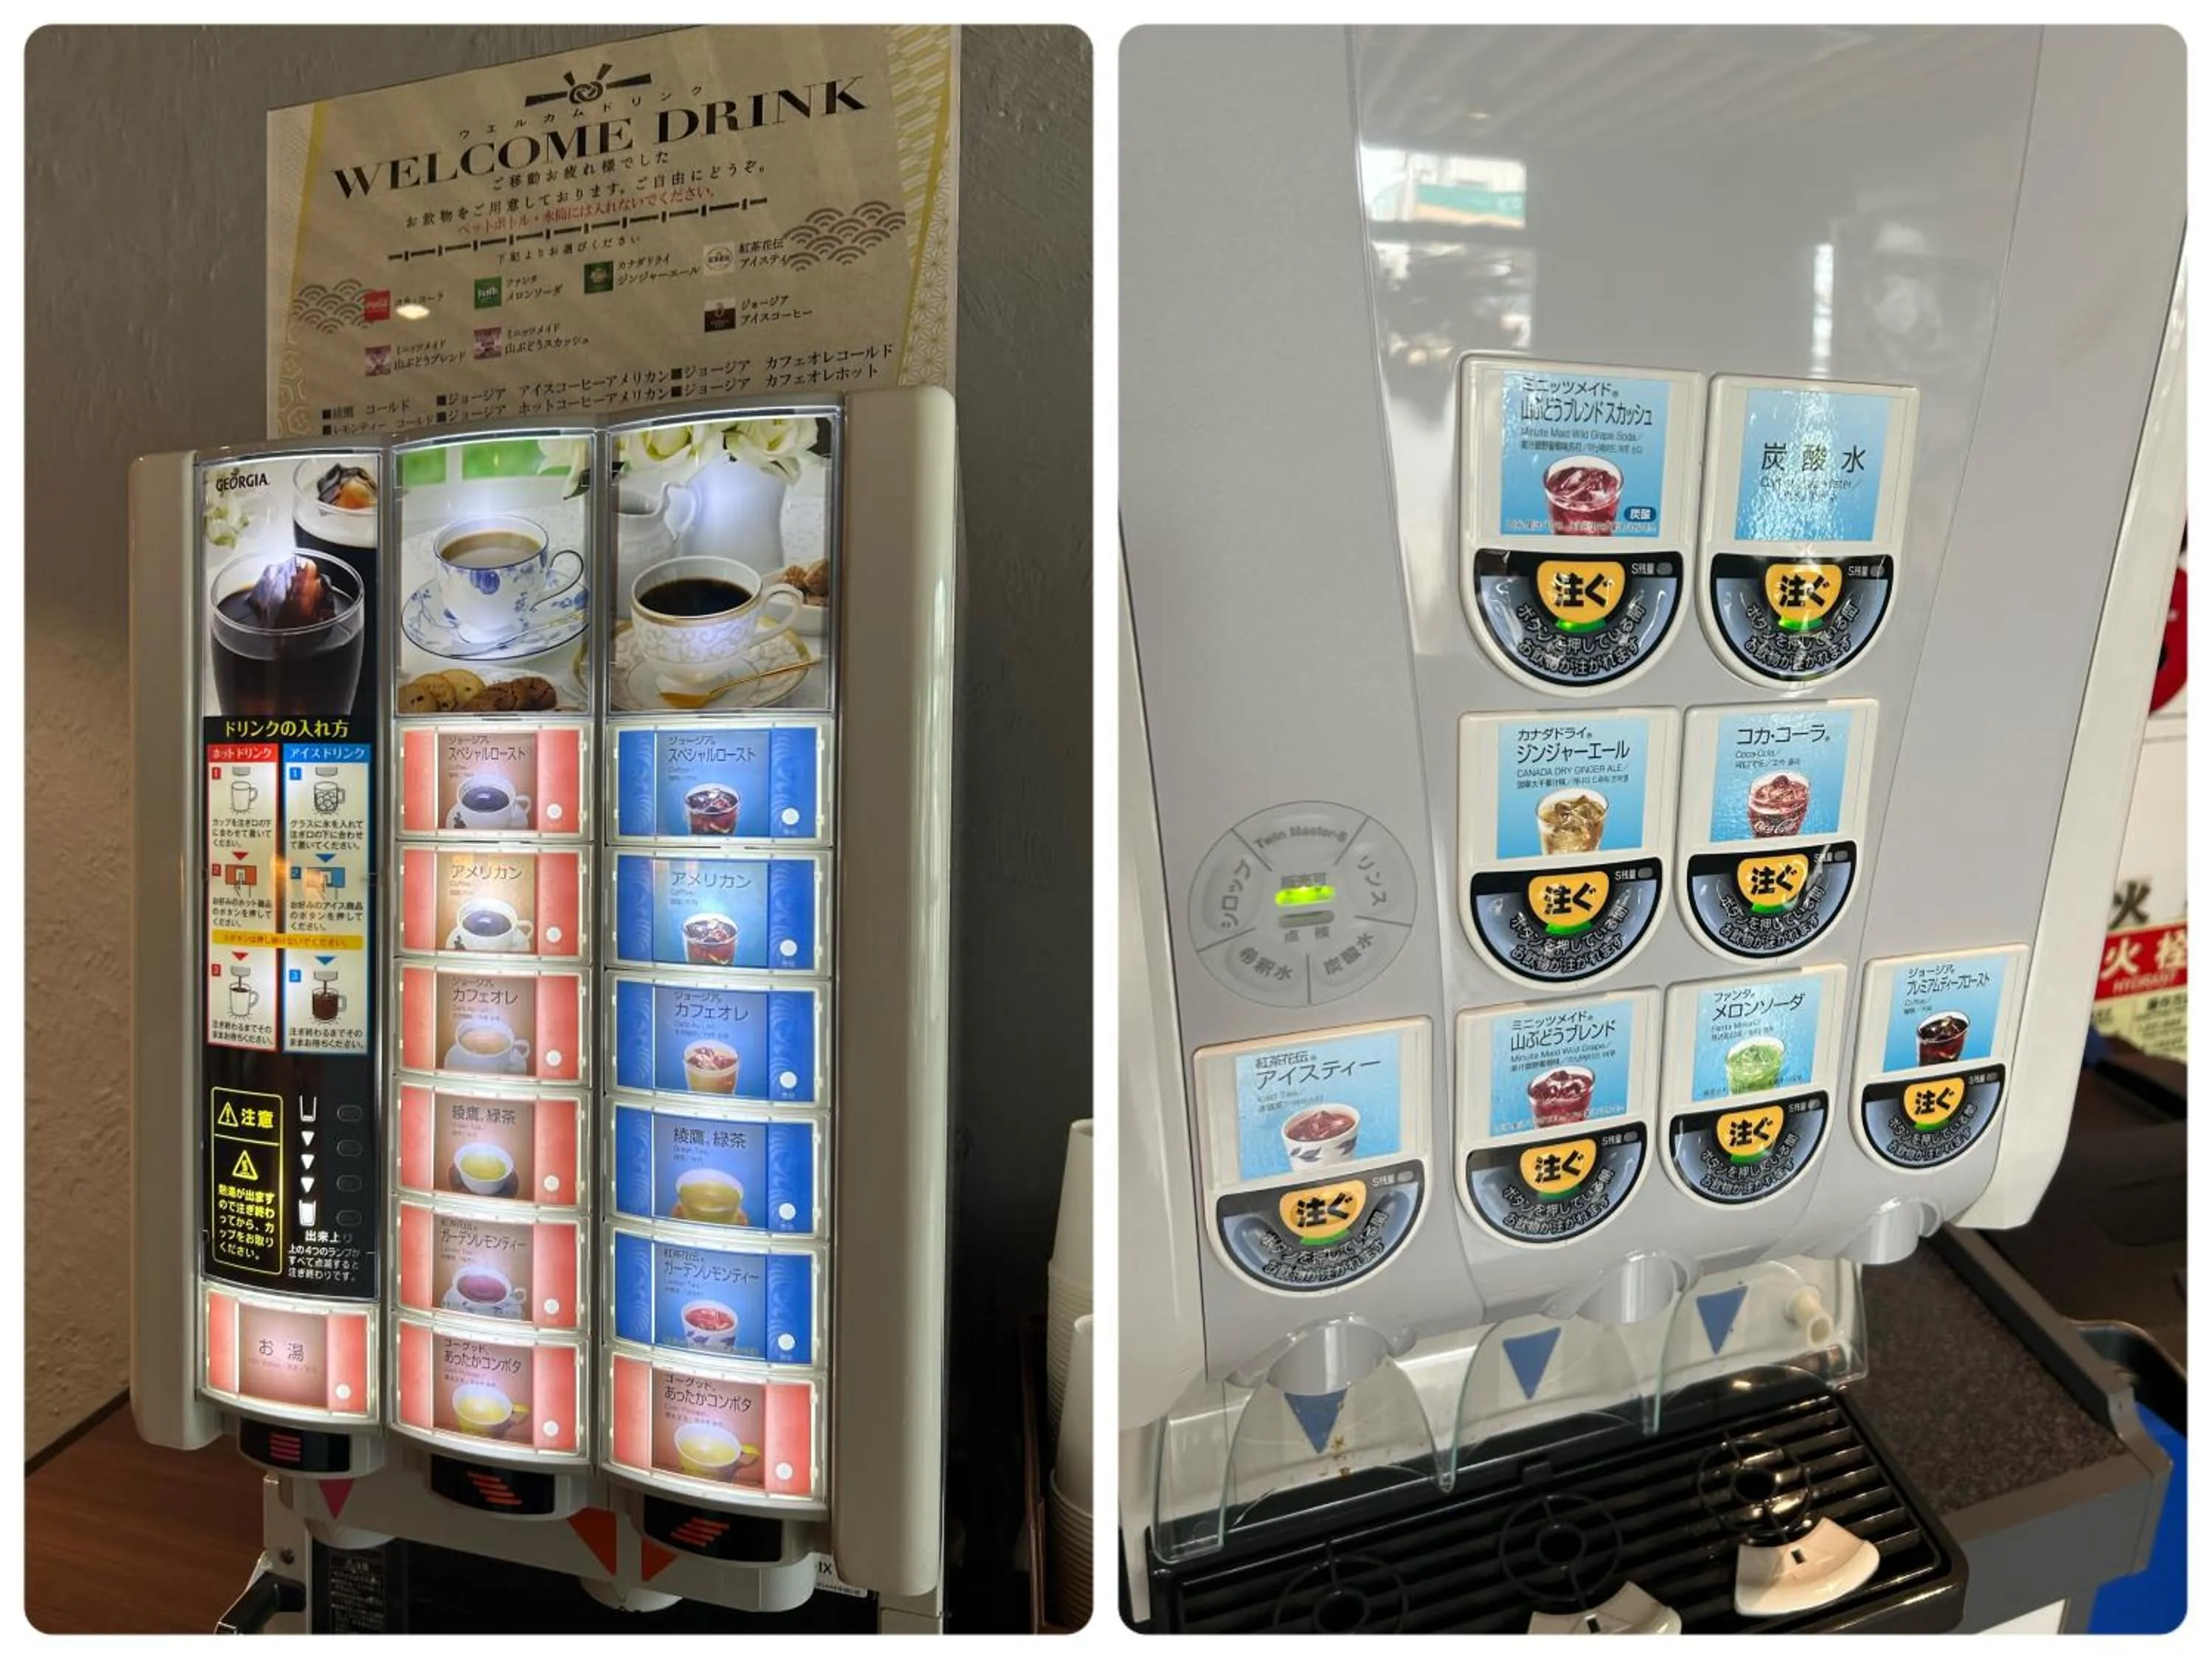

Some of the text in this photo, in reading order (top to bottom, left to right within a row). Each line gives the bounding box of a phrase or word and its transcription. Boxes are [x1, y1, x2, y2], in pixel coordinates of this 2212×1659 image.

[330, 75, 871, 200] WELCOME DRINK
[492, 150, 669, 191] ご移動お疲れ様でした
[618, 253, 671, 270] カナダドライ
[506, 274, 539, 287] ファンタ
[617, 264, 700, 286] ジンジャーエール
[507, 284, 563, 302] メロンソーダ
[741, 294, 790, 311] ジョージア
[741, 307, 814, 326] アイスコーヒー
[684, 344, 893, 380] ジョージア カフェオレコールド
[448, 371, 669, 407] ジョージア アイスコーヒーアメリカン
[684, 364, 878, 397] ジョージア カフェオレホット
[366, 398, 411, 416] コールド
[448, 388, 669, 424] ジョージア ホットコーヒーアメリカン
[1761, 442, 1866, 473] 炭酸水
[215, 473, 269, 493] GEORGIA
[1630, 507, 1652, 521] 炭酸
[1553, 572, 1609, 608] 注ぐ
[1778, 574, 1830, 608] 注ぐ
[225, 720, 349, 738] ドリンクの入れ方
[212, 748, 272, 759] ホットドリンク
[290, 747, 365, 759] アイスドリンク
[448, 747, 526, 762] スペシャルロースト
[668, 748, 757, 763] スペシャルロースト
[1517, 740, 1631, 765] ジンジャーエール
[1517, 767, 1553, 779] CANADA
[1554, 766, 1573, 775] DRY
[290, 818, 365, 830] グラスに氷を入れて
[1253, 831, 1287, 849] Twin
[451, 864, 524, 880] アメリカン
[672, 871, 752, 889] アメリカン
[1356, 855, 1388, 908] リンス
[1750, 864, 1798, 895] 注ぐ
[1220, 858, 1251, 929] シロップ
[1543, 883, 1596, 915] 注ぐ
[2108, 879, 2152, 931] 火
[1239, 947, 1293, 981] 希釈水
[1323, 932, 1374, 976] 炭酸水
[1905, 972, 1991, 996] プレミアムディープロースト
[452, 988, 519, 1006] カフェオレ
[1711, 992, 1806, 1021] メロンソーダ
[674, 1003, 749, 1021] カフェオレ
[1510, 1018, 1616, 1052] 山ぶどうブレンド
[1256, 1059, 1382, 1091] アイスティー
[1915, 1087, 1955, 1116] 注ぐ
[241, 1107, 274, 1129] 注意
[1728, 1116, 1773, 1147] 注ぐ
[1534, 1150, 1585, 1183] 注ぐ
[218, 1183, 276, 1205] 熱湯が出ます
[218, 1200, 275, 1218] ので注ぎ終わ
[1296, 1191, 1354, 1228] 注ぐ
[219, 1229, 274, 1248] ップをお取り
[442, 1229, 528, 1252] ガーデンレモンティー
[219, 1242, 260, 1261] ください。
[664, 1259, 759, 1285] ガーデンレモンティー
[259, 1338, 305, 1363] お湯
[444, 1349, 522, 1374] あったかコンポタ
[664, 1385, 753, 1413] あったかコンポタ
